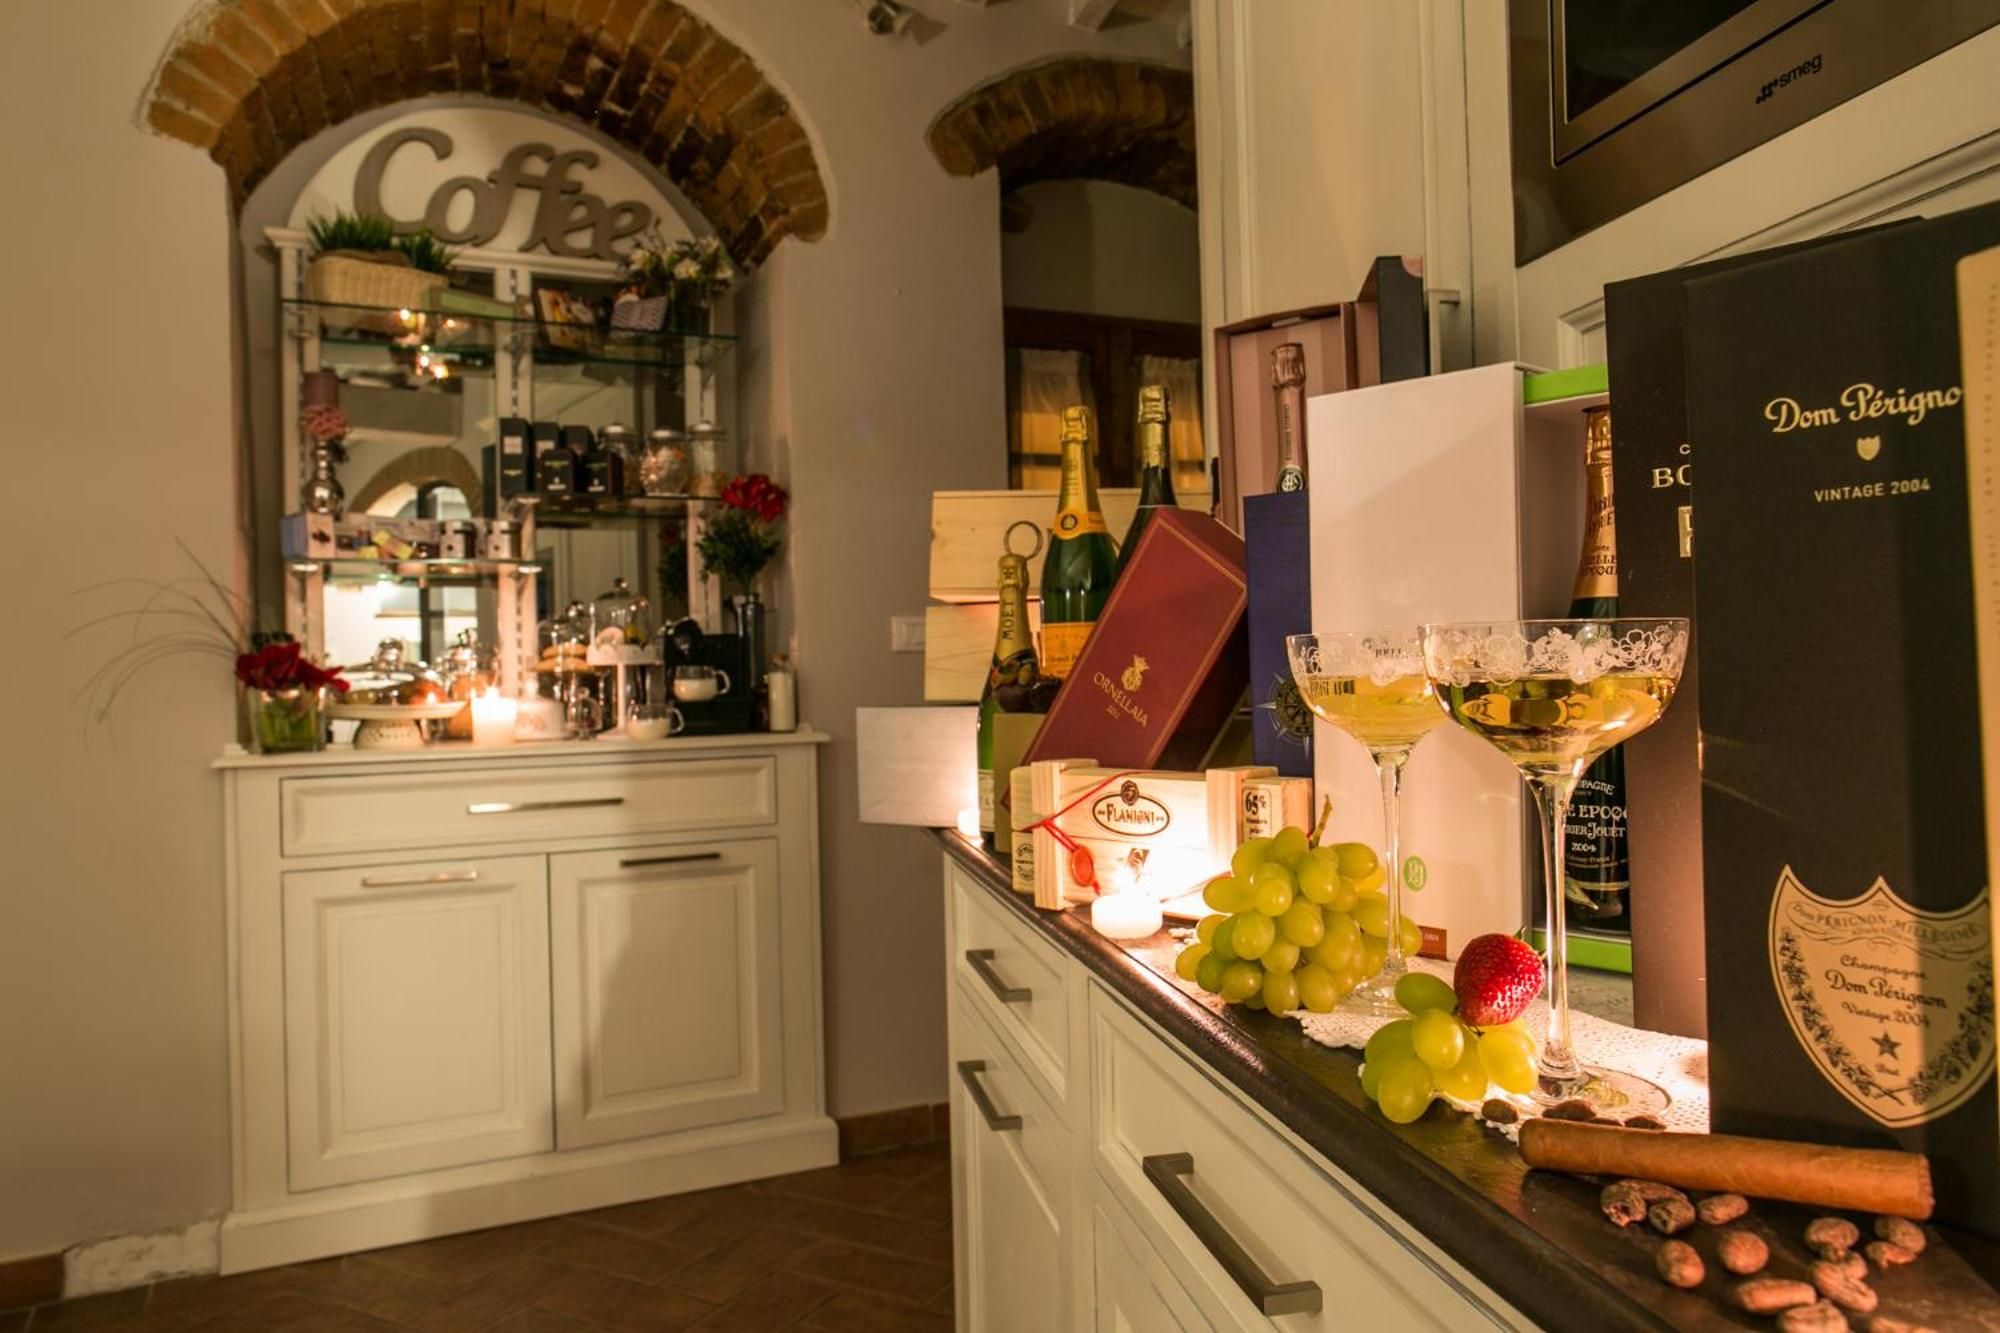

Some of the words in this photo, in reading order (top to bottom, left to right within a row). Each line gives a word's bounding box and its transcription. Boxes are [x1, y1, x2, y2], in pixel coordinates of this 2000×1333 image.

[1780, 54, 1822, 88] smeg
[353, 127, 652, 262] Coffee
[1764, 397, 1841, 433] Dom
[1840, 383, 1965, 426] Périgno
[1814, 482, 1885, 502] VINTAGE
[1890, 478, 1931, 494] 2004
[1094, 671, 1148, 728] ORNELLAIA
[1106, 803, 1156, 825] FLAMIGNI
[1578, 804, 1628, 822] EPOQ
[1571, 842, 1597, 853] 2004
[1840, 954, 1927, 980] Champagne
[1824, 969, 1869, 994] Dom
[1868, 976, 1948, 1010] Pérignon
[1841, 1001, 1891, 1023] Vintage
